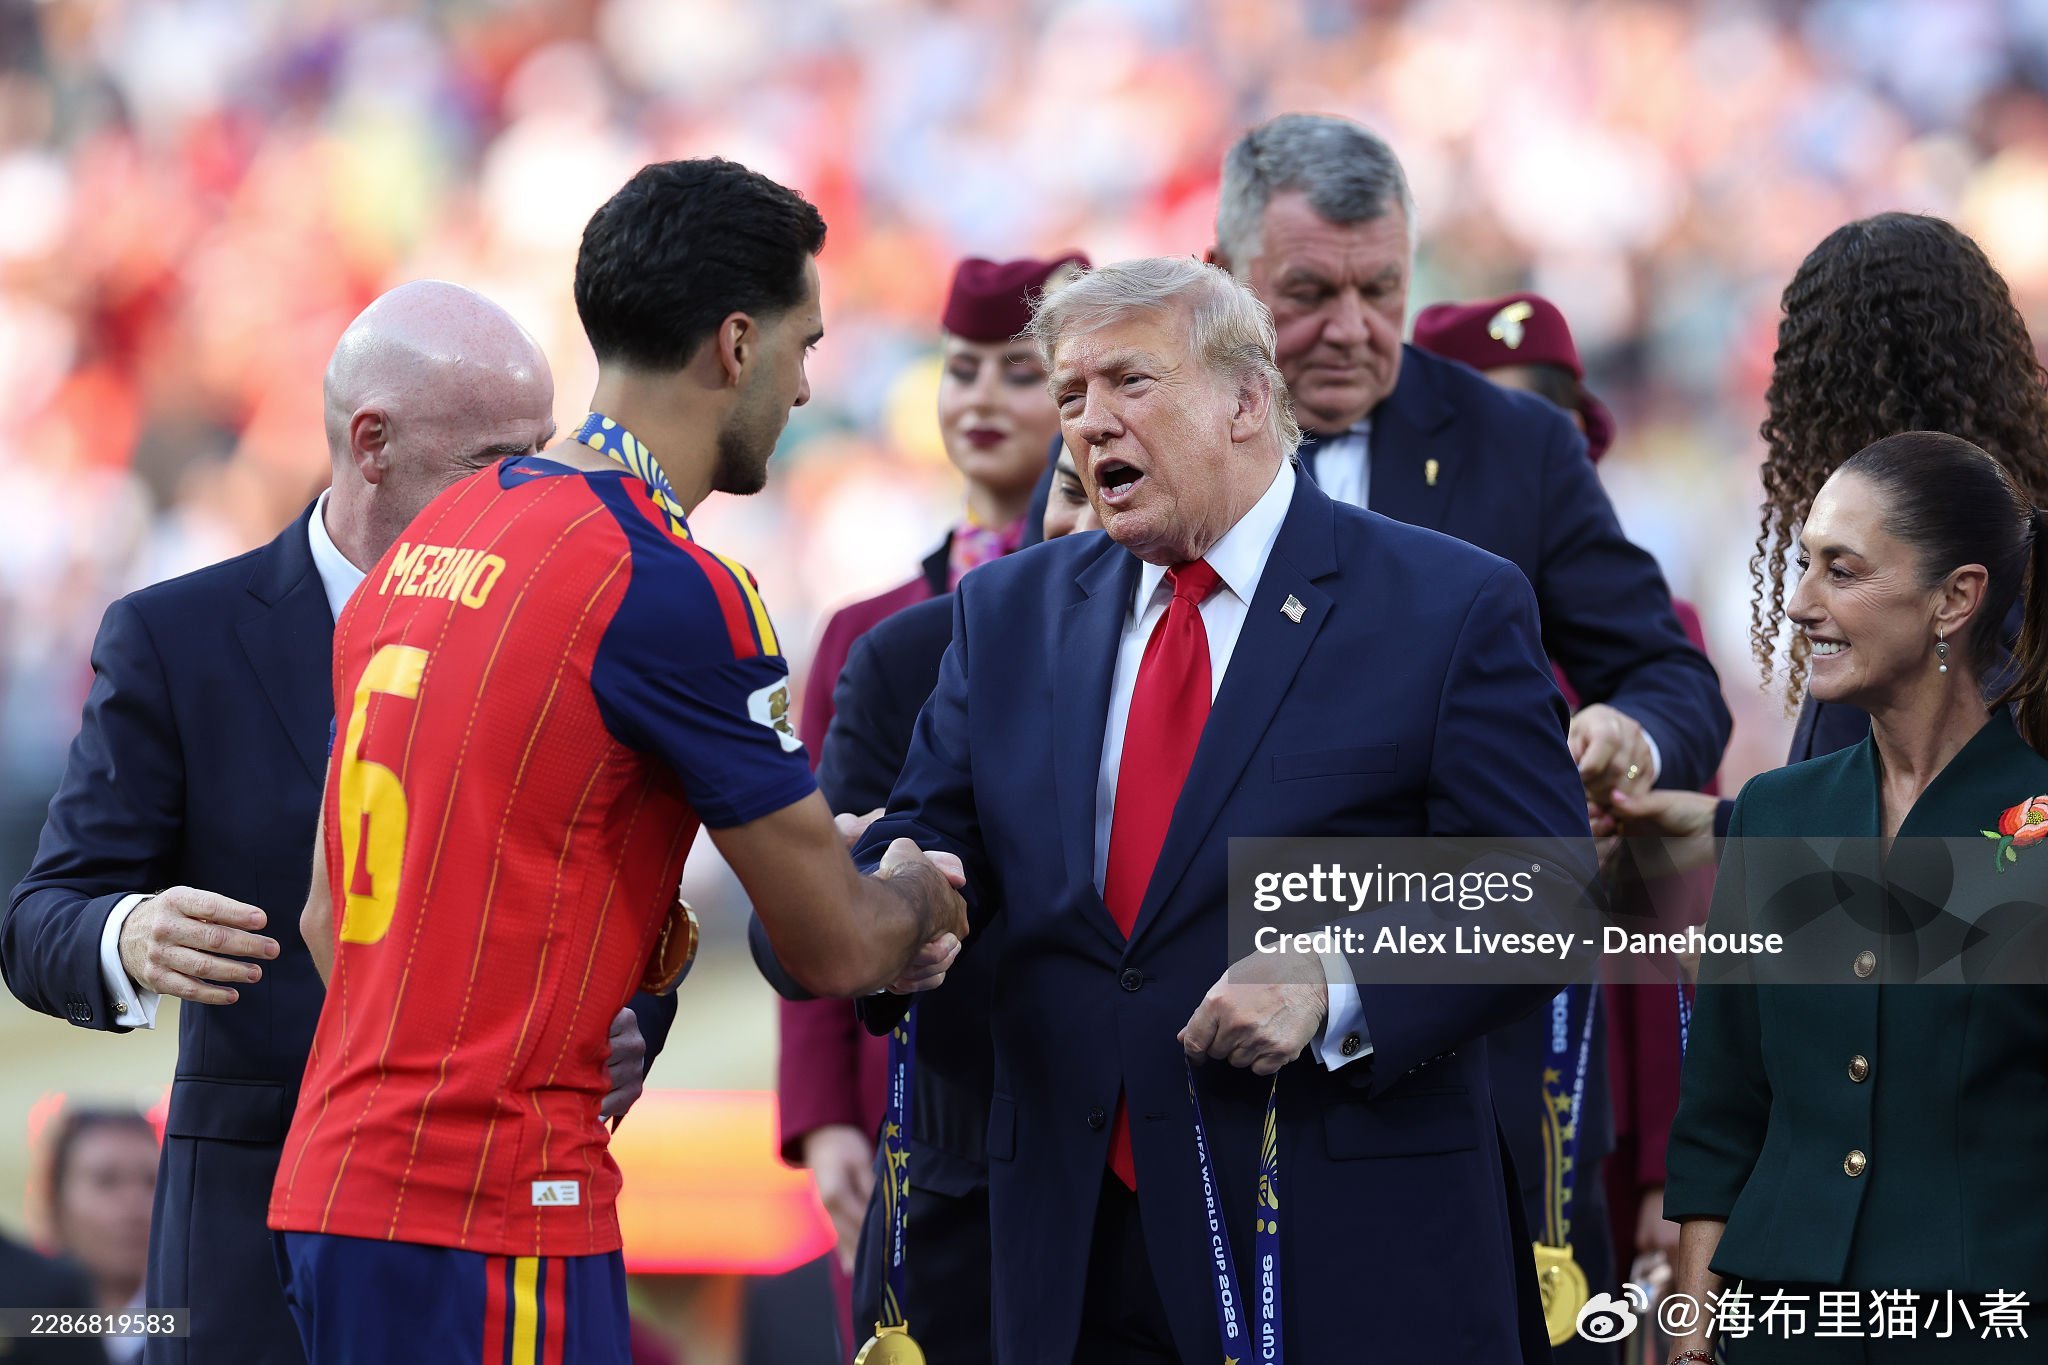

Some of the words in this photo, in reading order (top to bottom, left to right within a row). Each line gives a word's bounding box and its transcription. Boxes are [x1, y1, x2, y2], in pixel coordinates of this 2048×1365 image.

[378, 542, 506, 610] MERINO
[339, 644, 430, 945] 6
[1552, 991, 1568, 1053] 2026
[1195, 1125, 1206, 1164] FIFA
[1201, 1165, 1219, 1232] WORLD
[1212, 1234, 1227, 1271] CUP
[1218, 1274, 1239, 1339] 2026
[1262, 1254, 1274, 1320] 2026
[1262, 1322, 1275, 1360] CUP
